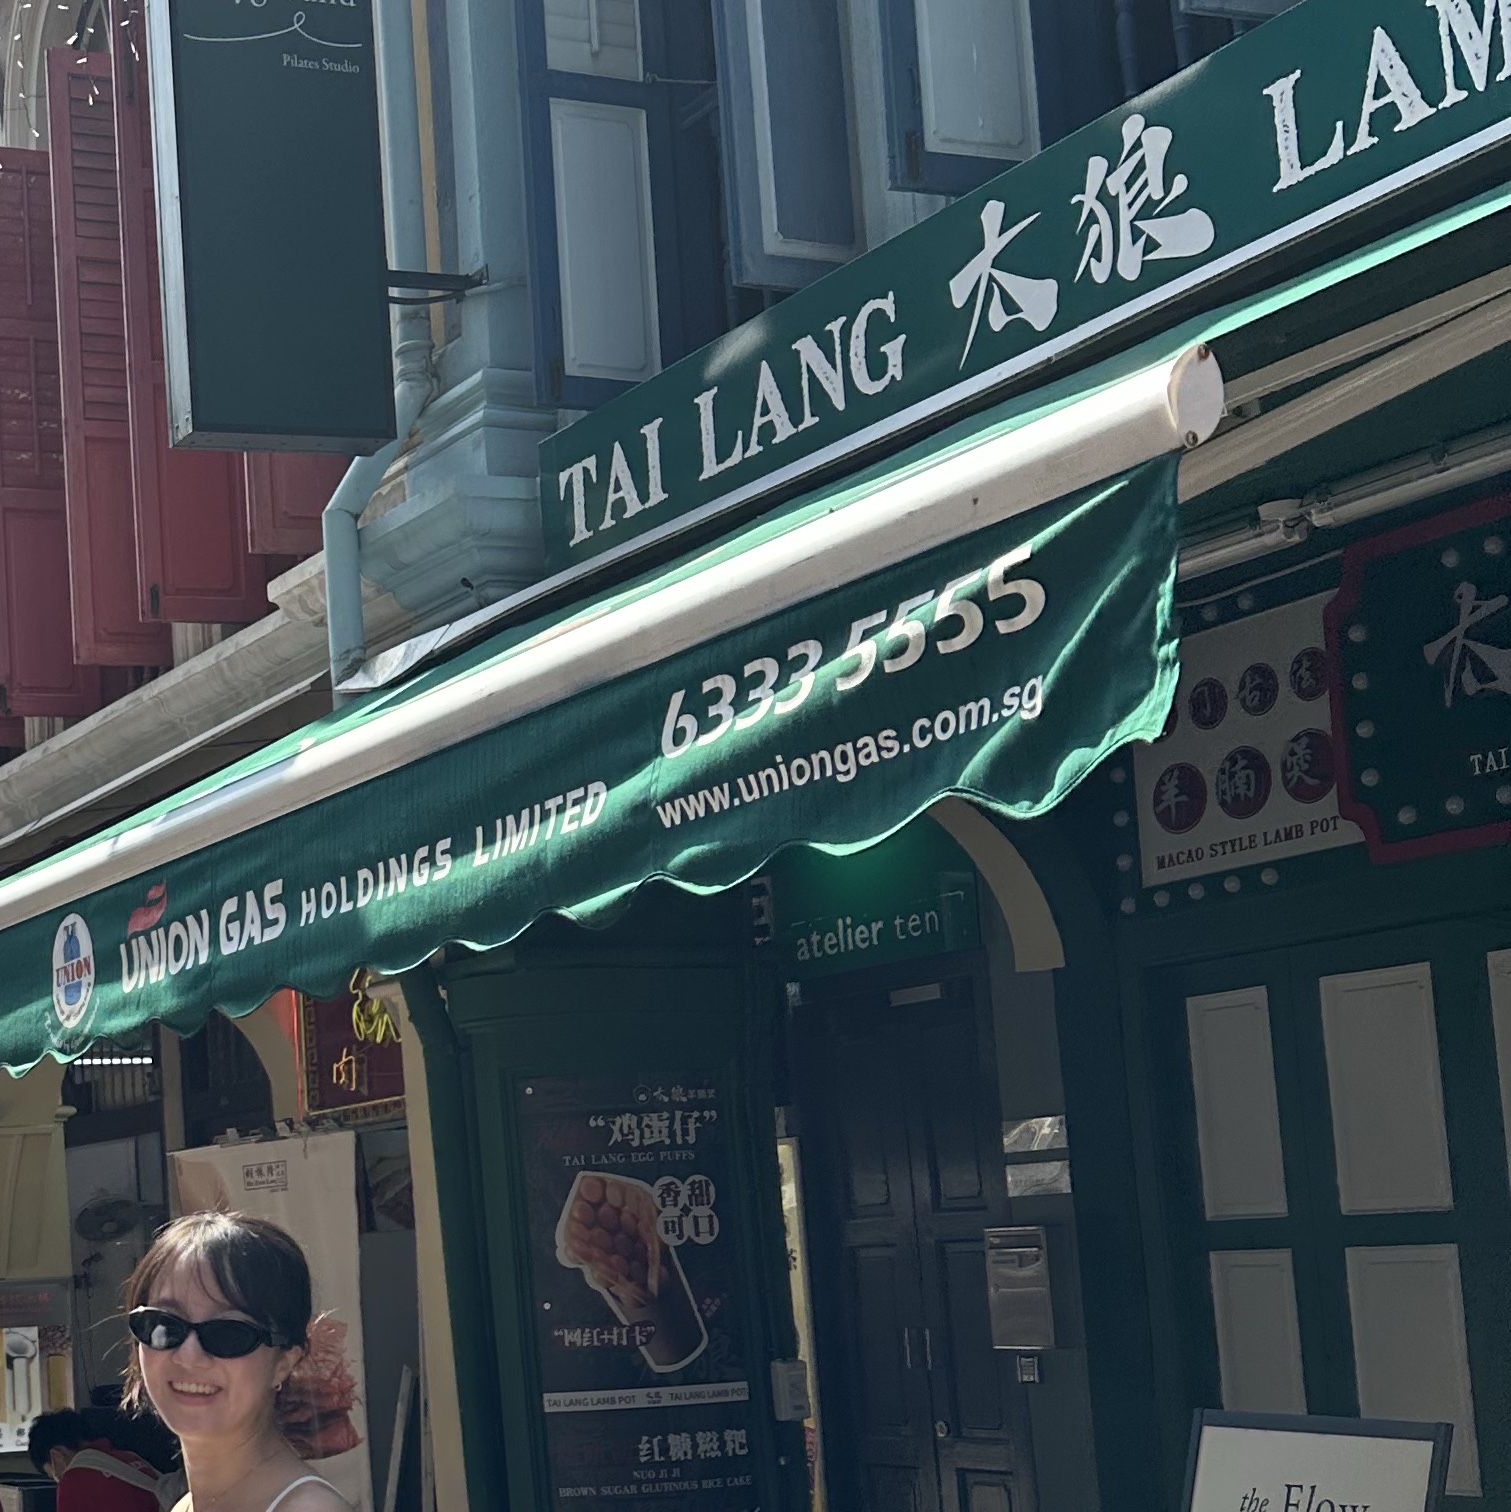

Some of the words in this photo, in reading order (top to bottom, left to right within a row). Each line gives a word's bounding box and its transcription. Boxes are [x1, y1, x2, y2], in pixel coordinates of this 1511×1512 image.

[282, 53, 320, 70] Pilates
[322, 57, 360, 74] Studio
[559, 417, 668, 547] TAI
[694, 291, 906, 481] LANG
[661, 638, 824, 759] 6333
[834, 542, 1047, 692] 5555
[656, 673, 1045, 829] www.uniongas.com.sg
[1156, 847, 1205, 871] MACAO
[1209, 833, 1258, 858] STYLE
[1262, 824, 1303, 847] LAMB
[1310, 815, 1340, 834] POT
[120, 908, 210, 995] UNION
[219, 878, 287, 955] GAS
[300, 837, 453, 927] HOLDINGS
[471, 780, 609, 868] LIMITED
[796, 915, 884, 962] atelier
[894, 909, 940, 940] ten
[55, 955, 92, 988] UNION
[562, 1154, 586, 1167] TAI
[591, 1153, 626, 1165] LANG
[631, 1151, 655, 1163] EGG
[659, 1150, 696, 1162] PUFFS
[661, 1212, 716, 1241] 可口
[546, 1398, 561, 1408] TAI
[565, 1397, 588, 1408] LANG
[618, 1395, 636, 1405] POT
[669, 1392, 683, 1401] TAI
[730, 1387, 748, 1398] POT
[559, 1487, 597, 1498] BROWN
[600, 1485, 638, 1496] SUGAR
[702, 1478, 724, 1489] RICE
[726, 1475, 752, 1487] CAKE
[633, 1469, 656, 1480] NUO
